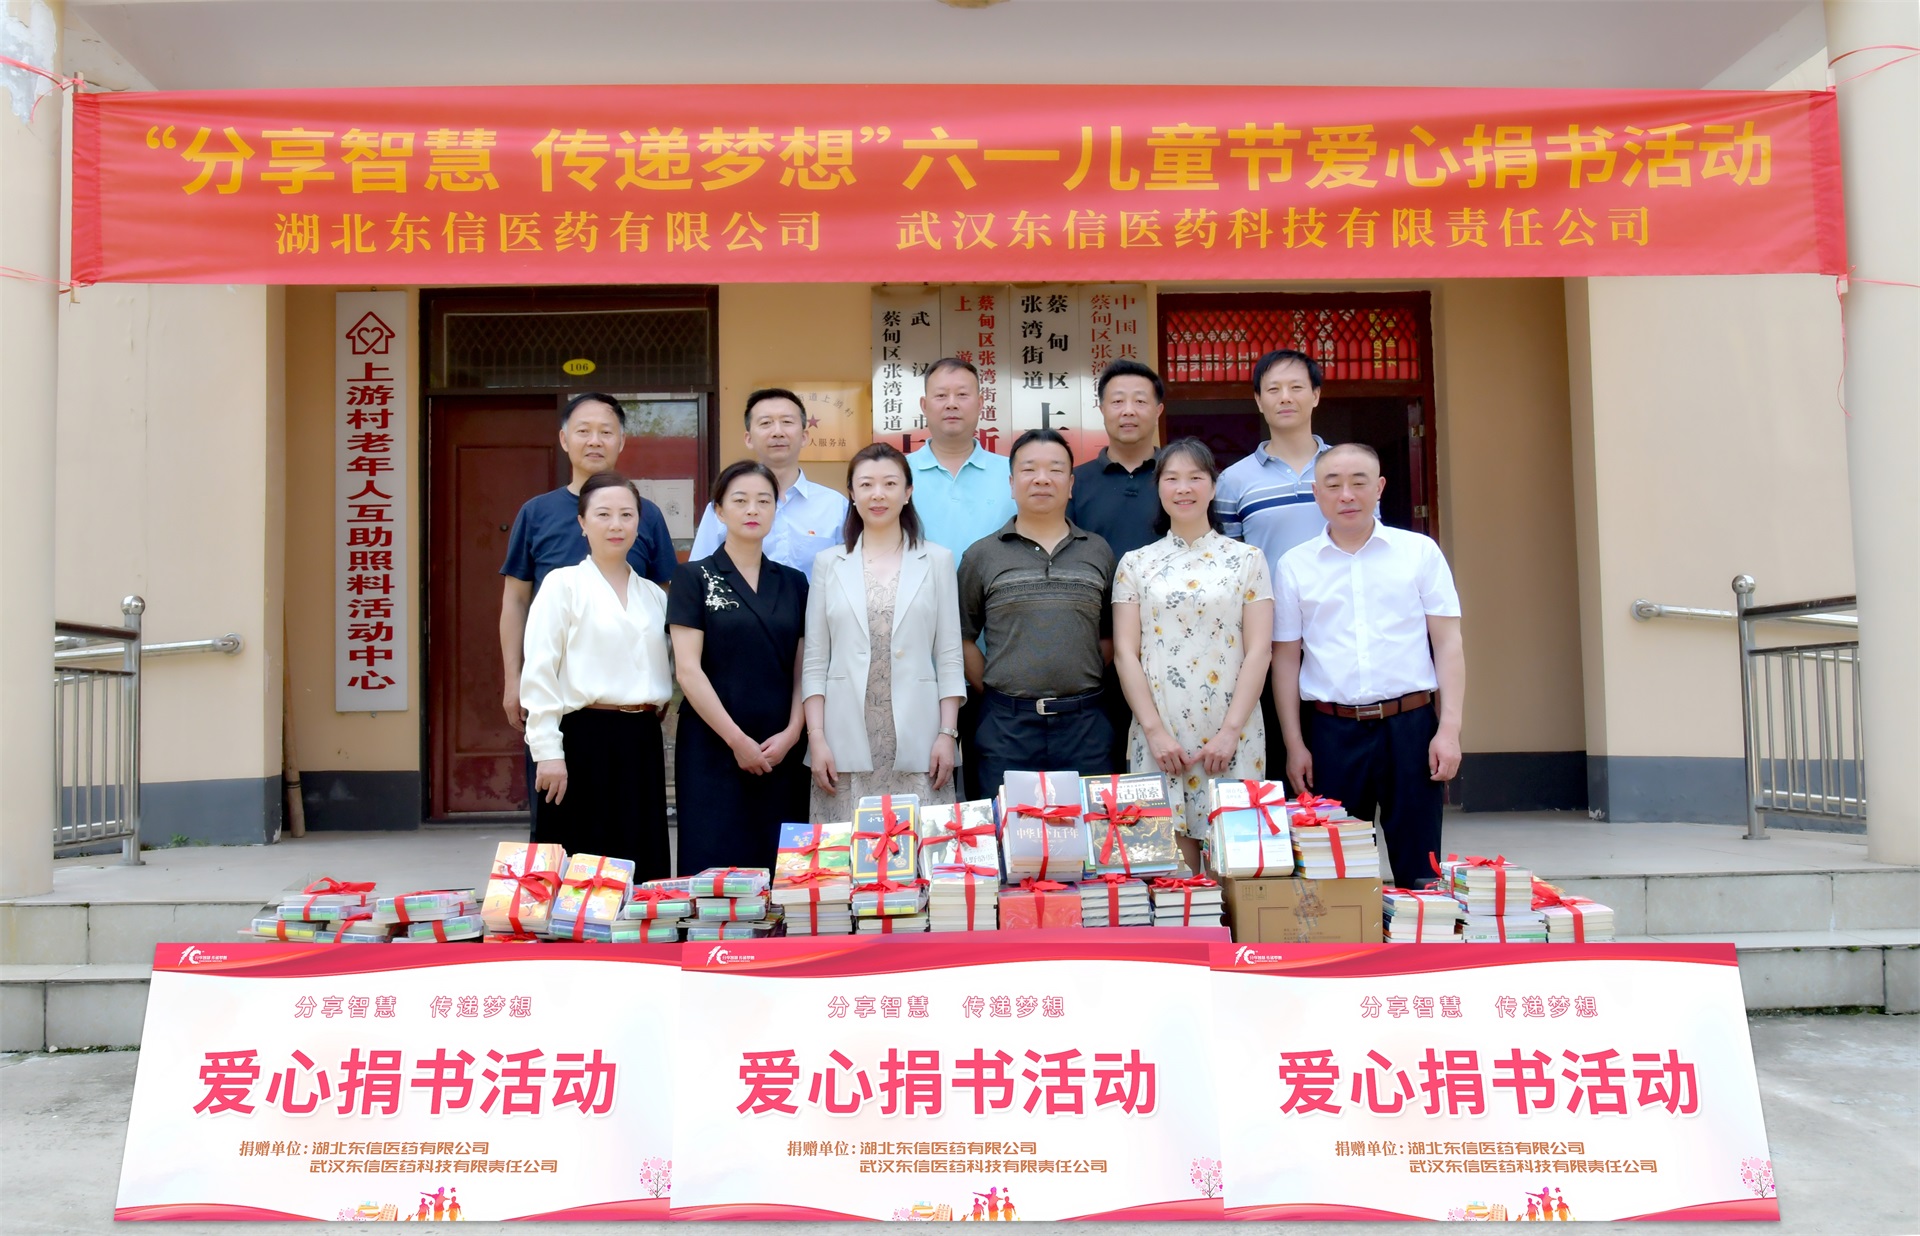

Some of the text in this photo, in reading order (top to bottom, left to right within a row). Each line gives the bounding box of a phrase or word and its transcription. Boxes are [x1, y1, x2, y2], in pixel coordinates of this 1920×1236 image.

[275, 206, 1651, 255] 湖北东信医药有限公司 武汉东信医药科技有限责任公司
[978, 295, 997, 422] 蔡甸区张湾街道
[1021, 295, 1044, 389] 张湾街道
[1047, 294, 1069, 389] 蔡甸区
[1115, 294, 1138, 359] 中国共
[570, 363, 589, 372] 106
[882, 311, 903, 431] 蔡甸区张湾街道
[346, 361, 395, 690] 上游村老年人互助照料活动中心
[295, 995, 532, 1018] 分享智慧 传递梦想
[827, 995, 1065, 1018] 分享智慧 传递梦想
[1360, 995, 1598, 1018] 分享智慧 传递梦想
[193, 1048, 617, 1115] 爱心捐书活动
[737, 1048, 1156, 1115] 爱心捐书活动
[1278, 1048, 1699, 1115] 爱心捐书活动
[309, 1159, 558, 1174] 武汉东信医药科技有限责任公司
[859, 1159, 1108, 1174] 武汉东信医药科技有限责任公司
[1409, 1159, 1658, 1174] 武汉东信医药科技有限责任公司
